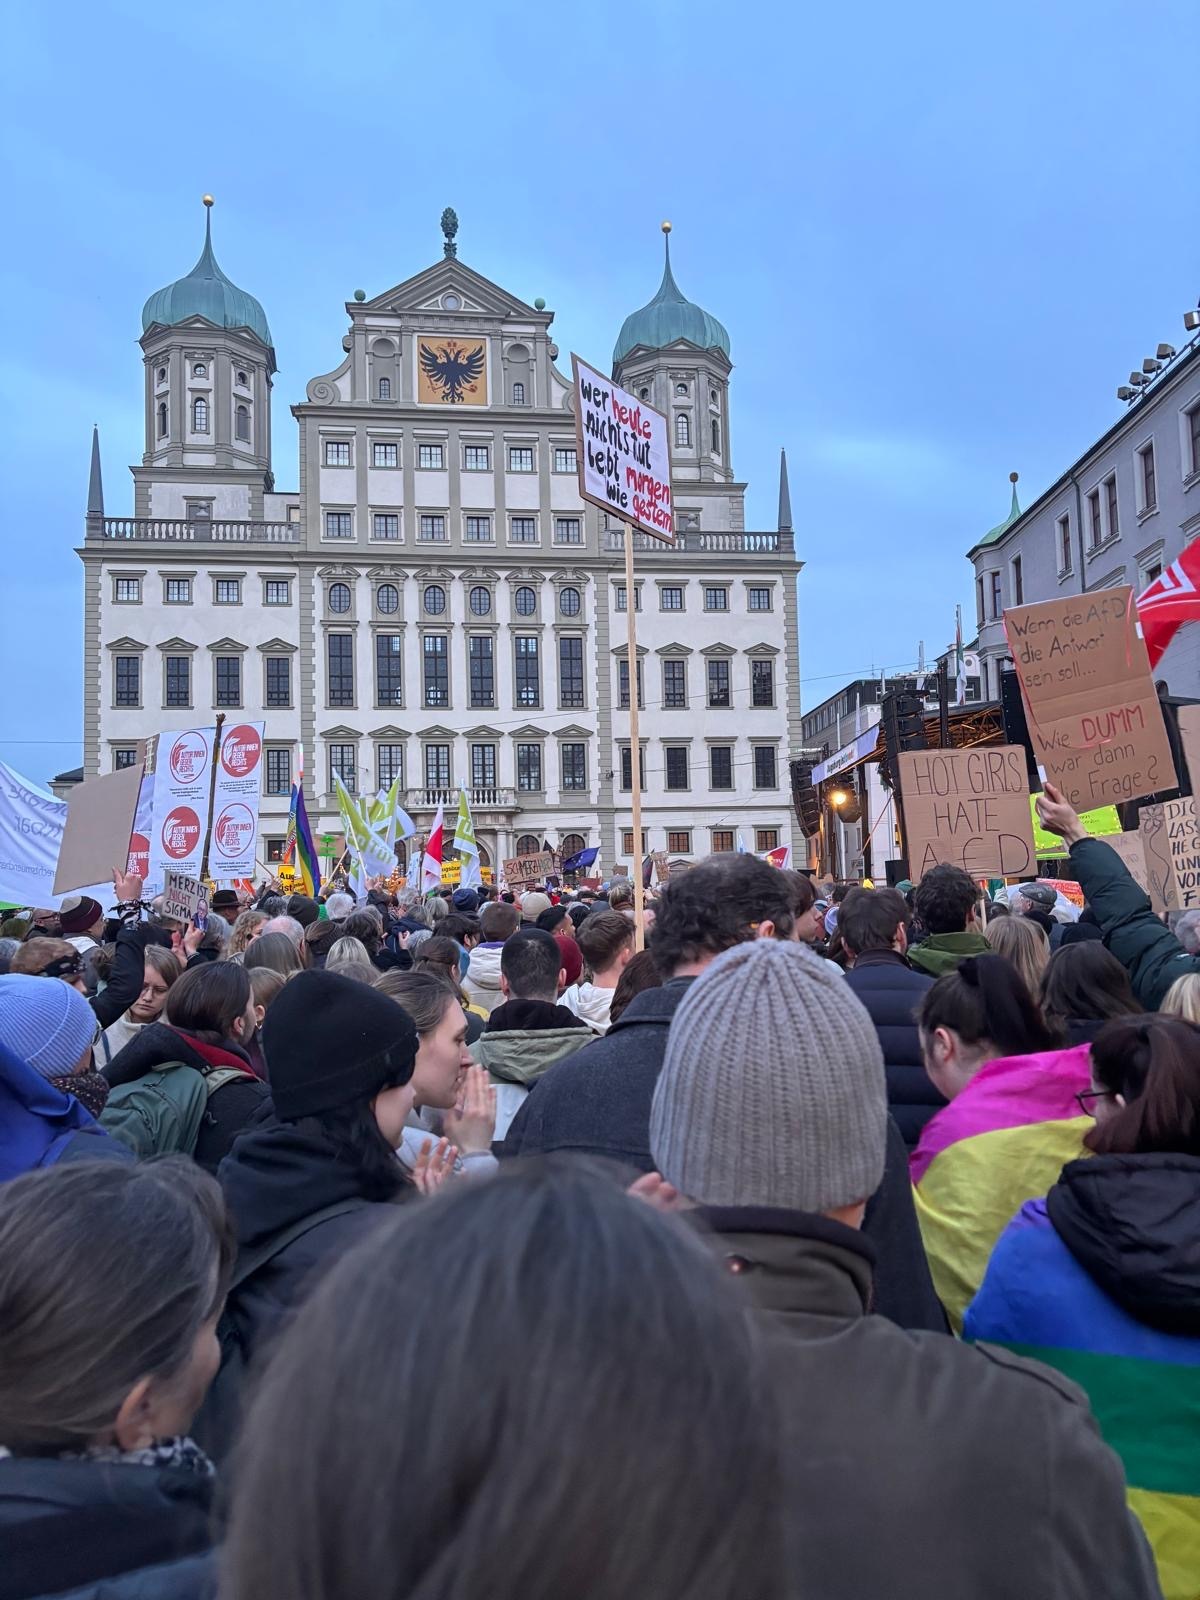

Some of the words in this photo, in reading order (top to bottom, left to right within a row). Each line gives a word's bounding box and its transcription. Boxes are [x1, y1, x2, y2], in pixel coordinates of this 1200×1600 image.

[581, 379, 608, 411] wer
[612, 389, 651, 439] heute
[587, 410, 629, 455] nichts
[588, 440, 619, 481] lebt
[626, 467, 670, 504] morgen
[607, 480, 627, 508] wie
[632, 494, 672, 532] gestern
[1011, 616, 1055, 637] Wenn
[1063, 606, 1082, 627] die
[1086, 597, 1126, 624] AfD
[1020, 641, 1042, 664] die
[1025, 668, 1052, 688] sein
[1058, 662, 1096, 682] soll...
[1037, 728, 1071, 751] Wie
[1082, 705, 1144, 742] DUMM
[913, 755, 959, 796] HOT
[968, 752, 1022, 793] GIRLS
[1051, 754, 1082, 774] war
[1094, 744, 1135, 766] dann
[934, 798, 1000, 837] HATE
[169, 874, 195, 894] MERZ
[197, 884, 208, 899] IST
[169, 888, 191, 905] NICHT
[165, 901, 191, 918] SIGMA
